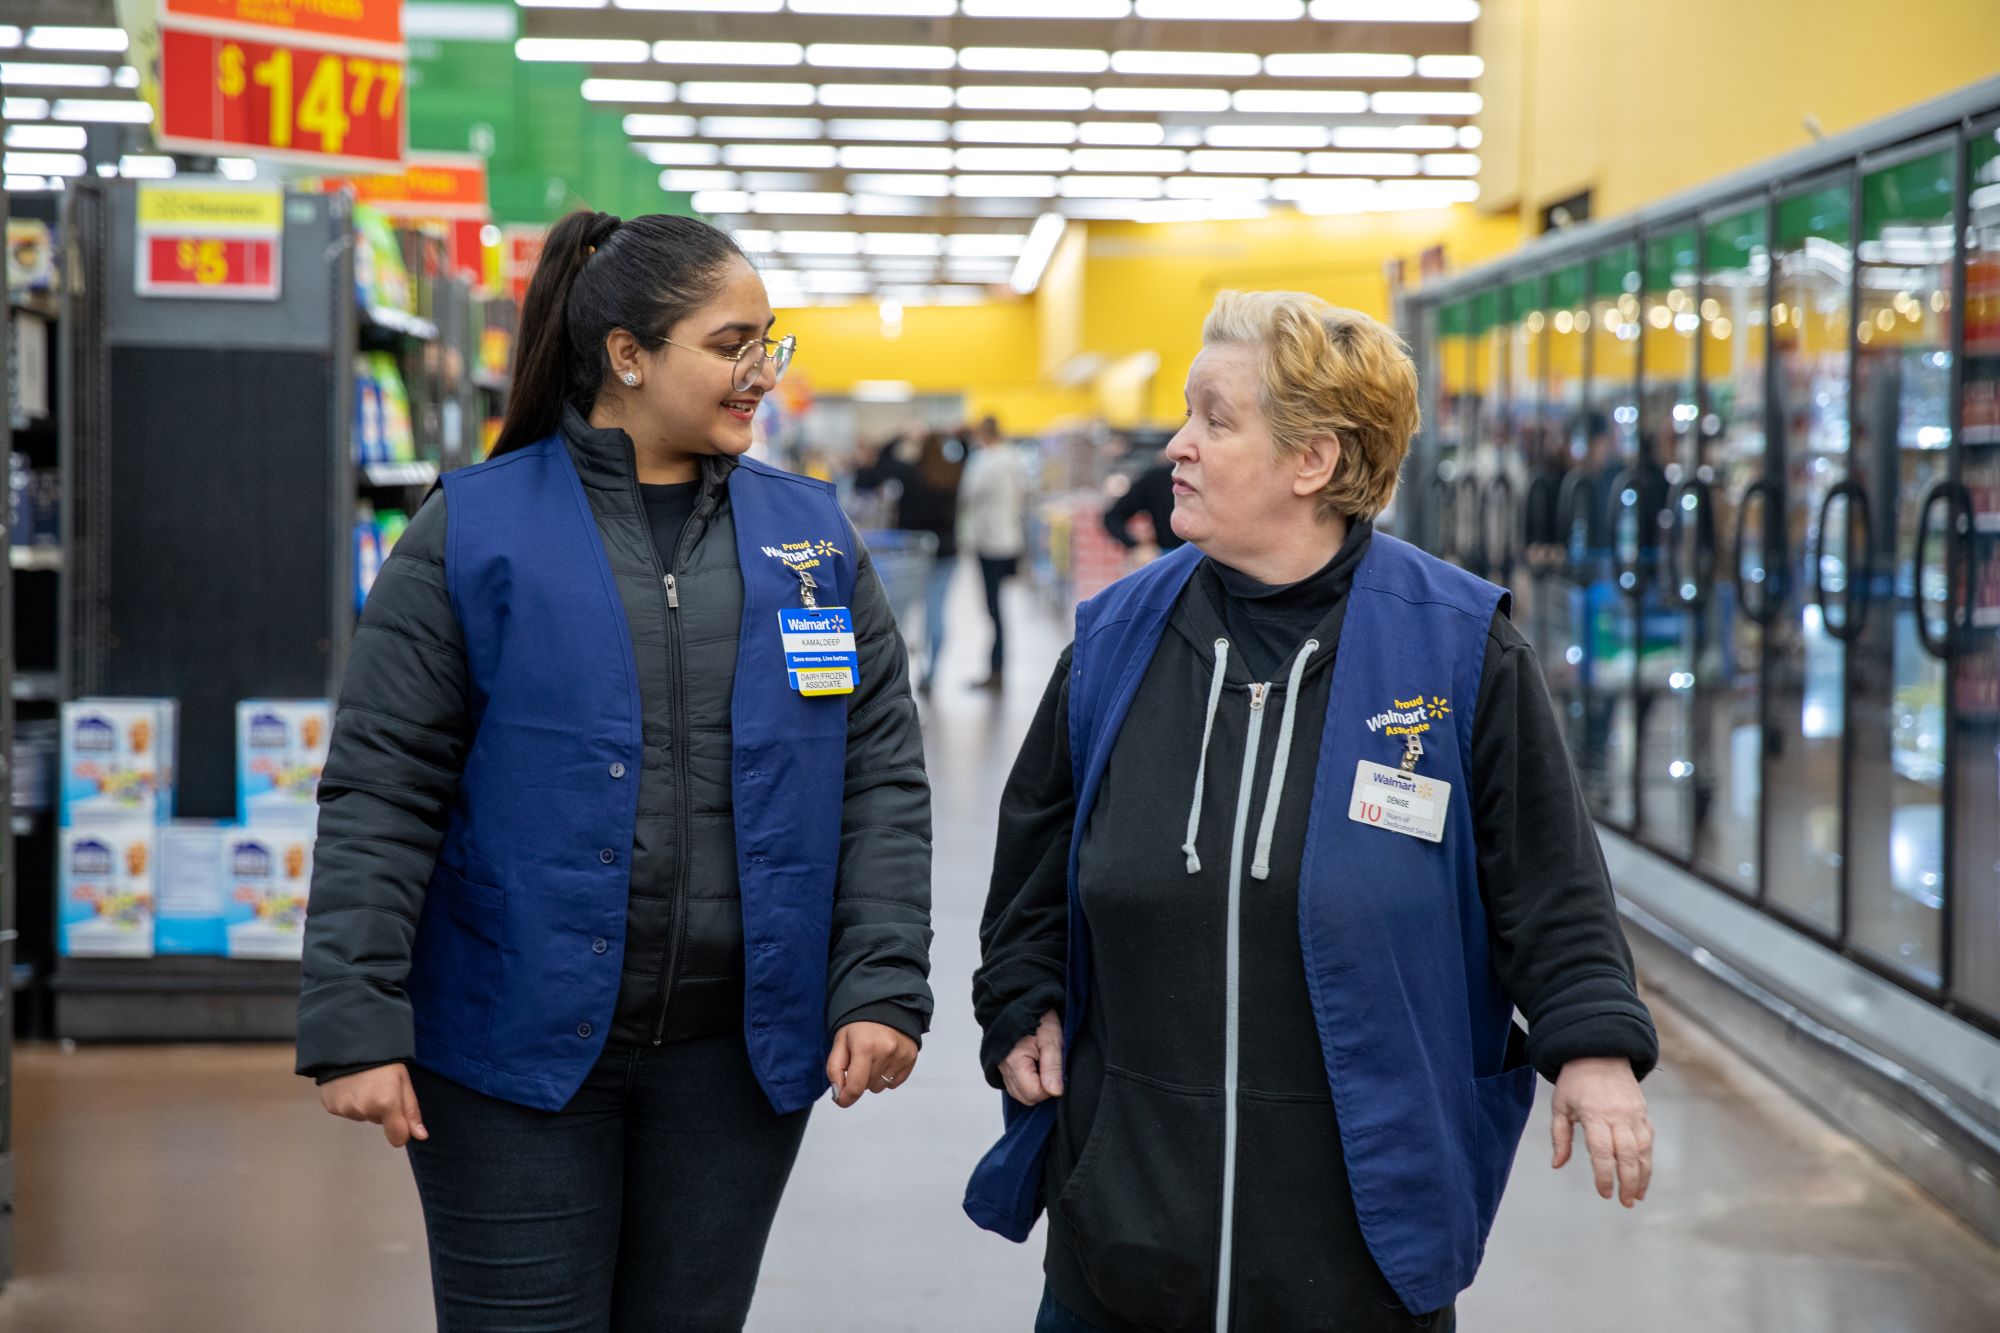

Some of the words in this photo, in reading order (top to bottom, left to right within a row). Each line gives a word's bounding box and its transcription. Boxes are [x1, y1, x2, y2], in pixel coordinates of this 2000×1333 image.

[782, 540, 811, 550] Proud
[788, 618, 831, 631] Walmart
[801, 671, 848, 681] DAIRY/FROZEN
[805, 680, 842, 689] ASSOCIATE
[1394, 695, 1423, 708] Proud
[1366, 707, 1427, 732] Walmart
[1385, 723, 1430, 736] Associate
[1373, 772, 1416, 792] Walmart
[1386, 796, 1409, 808] DENISE
[1360, 801, 1381, 822] 10
[1402, 815, 1410, 823] of
[1415, 827, 1438, 838] Service
